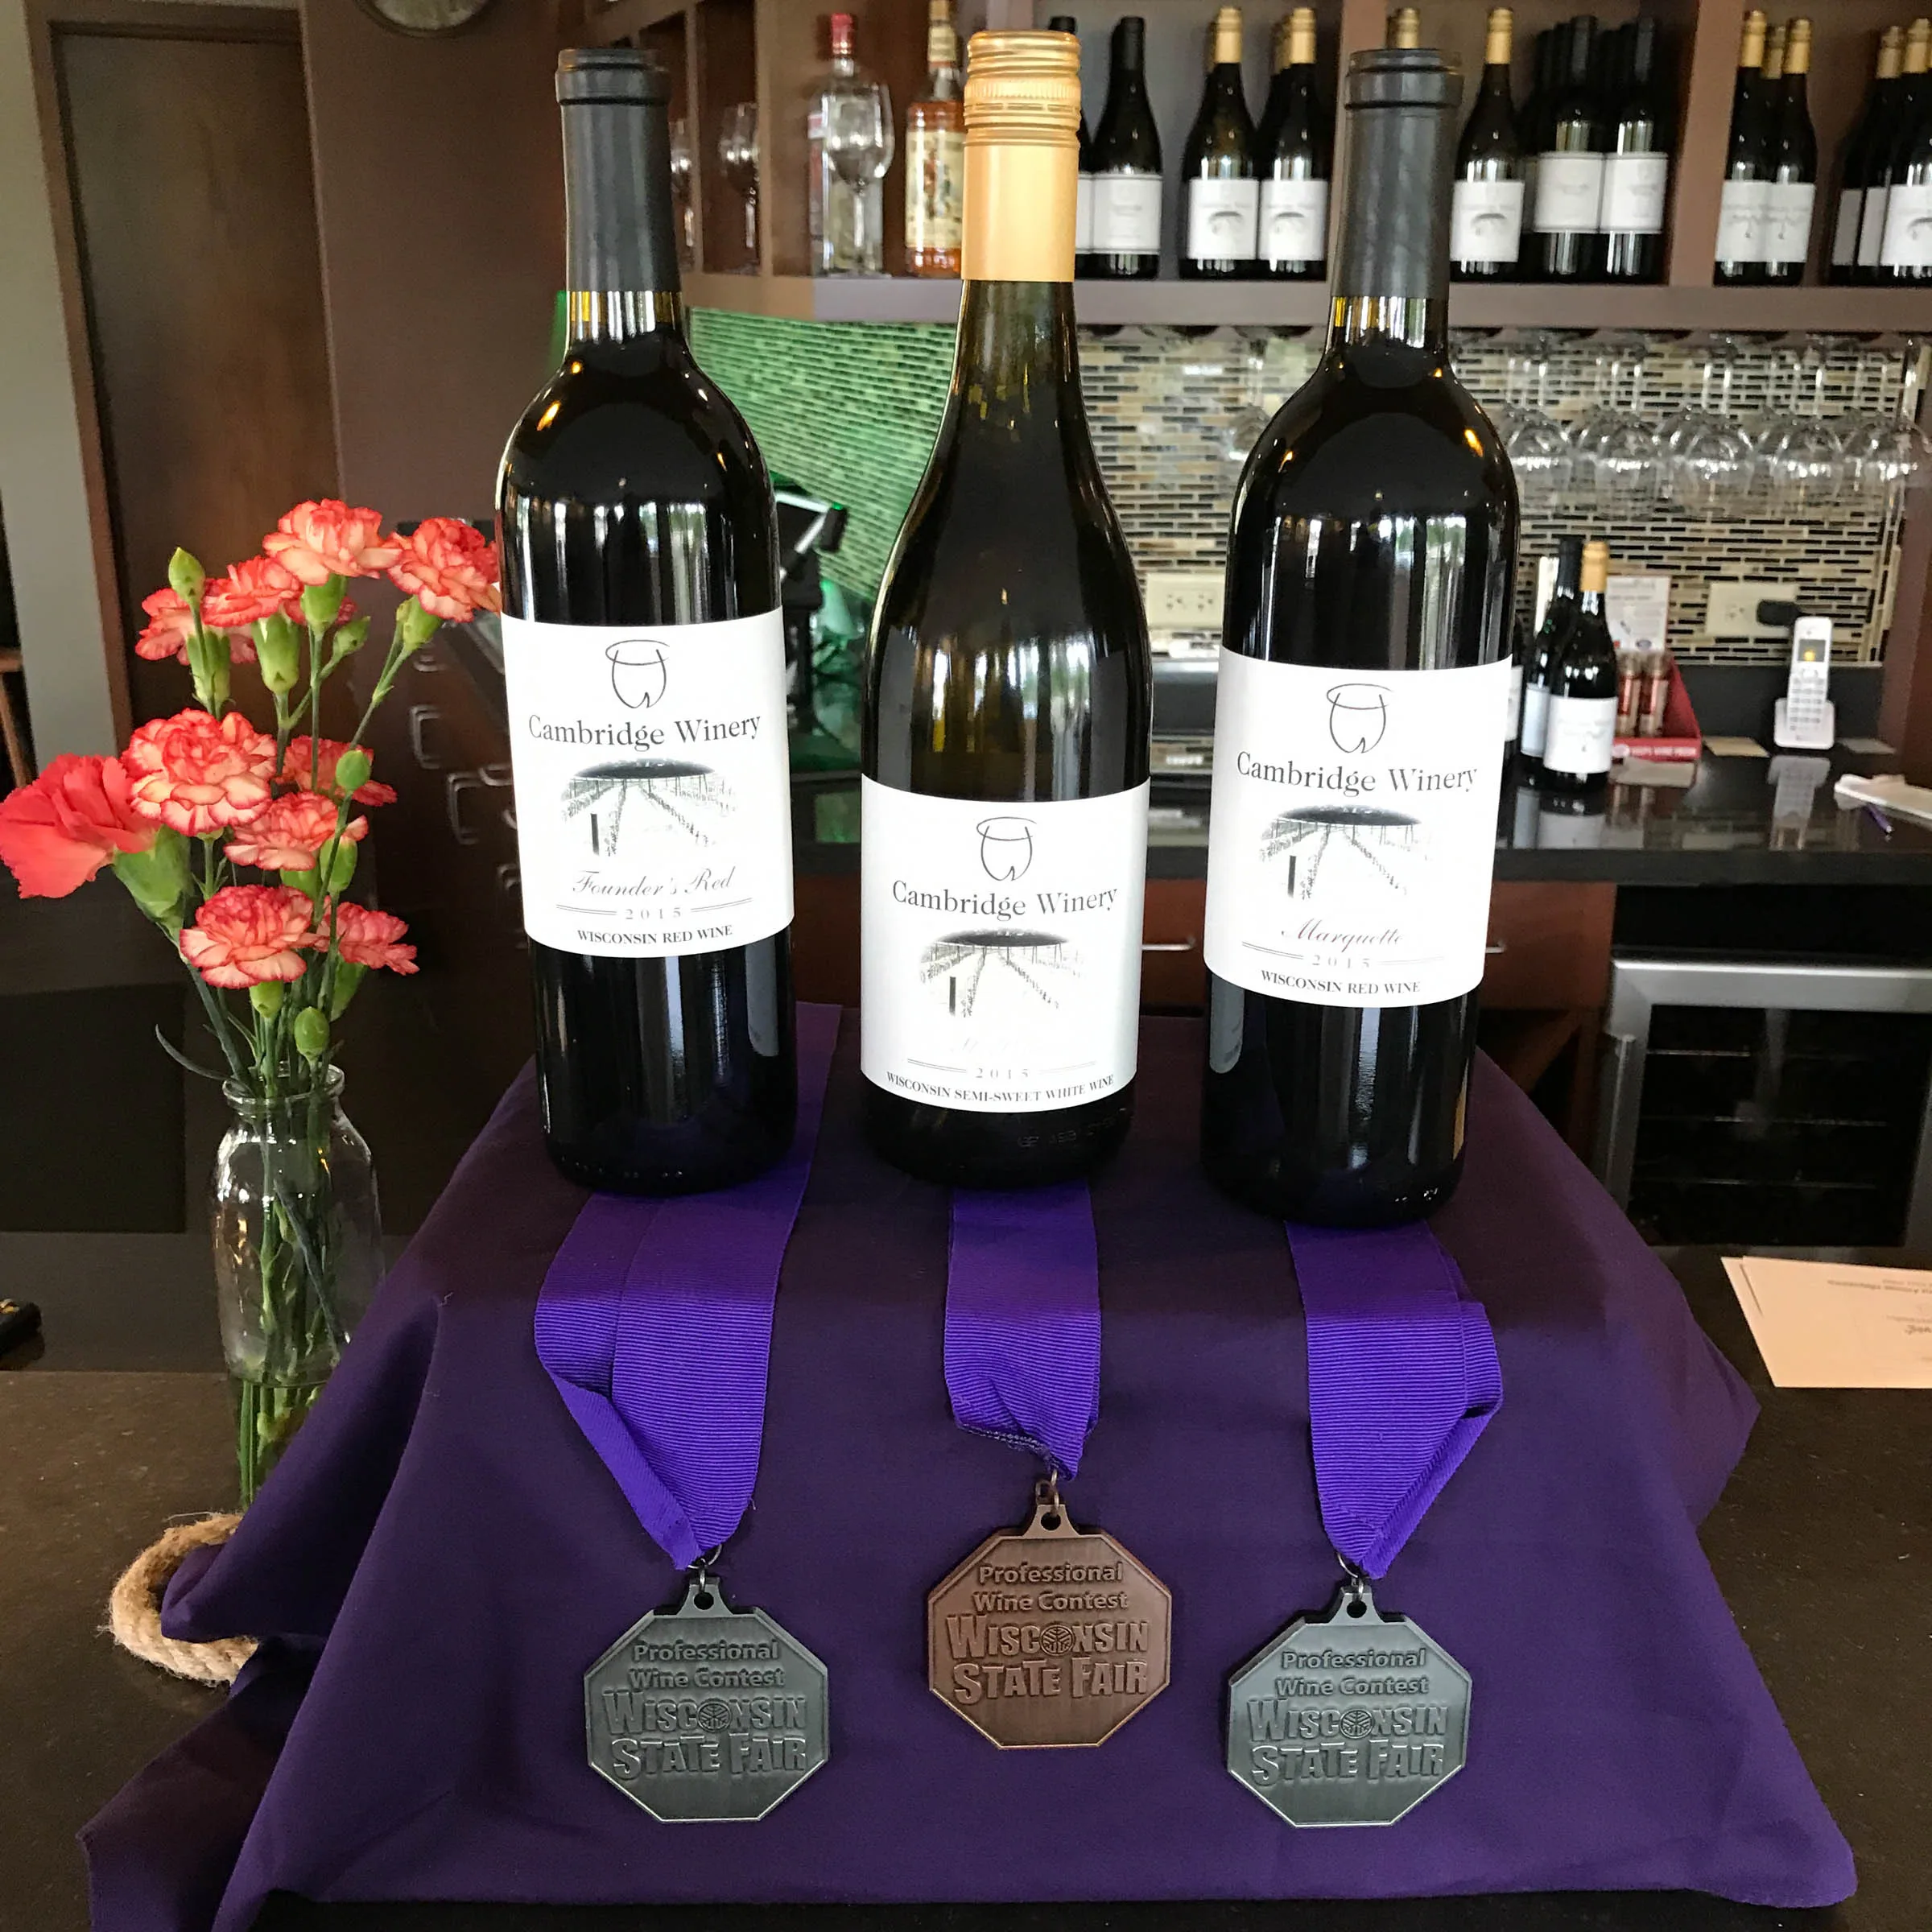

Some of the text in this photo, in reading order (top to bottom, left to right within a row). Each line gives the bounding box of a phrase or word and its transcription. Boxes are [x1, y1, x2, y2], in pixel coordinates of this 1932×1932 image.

[528, 714, 762, 753] Cambridge Winery
[1236, 750, 1479, 798] Cambridge Winery
[572, 865, 737, 897] Founder's Red
[892, 879, 1118, 922] Cambridge Winery
[625, 907, 682, 921] 2015
[577, 924, 733, 945] WISCONSIN RED WINE
[1312, 954, 1371, 968] 2015
[1261, 969, 1422, 995] WISCONSIN RED WINE
[886, 1070, 1115, 1102] WISCONSIN SEMI-SWEET WHITE WINE
[978, 1562, 1124, 1584] Professional
[972, 1590, 1129, 1611] Wine Contest
[633, 1639, 778, 1662] Professional
[1281, 1648, 1426, 1669] Professional
[628, 1666, 786, 1688] Wine Contest
[952, 1655, 1148, 1704] STATE FAIR
[1275, 1676, 1430, 1696] Wine Contest
[611, 1732, 806, 1781] STATE FAIR
[1251, 1738, 1445, 1786] STATE FAIR
